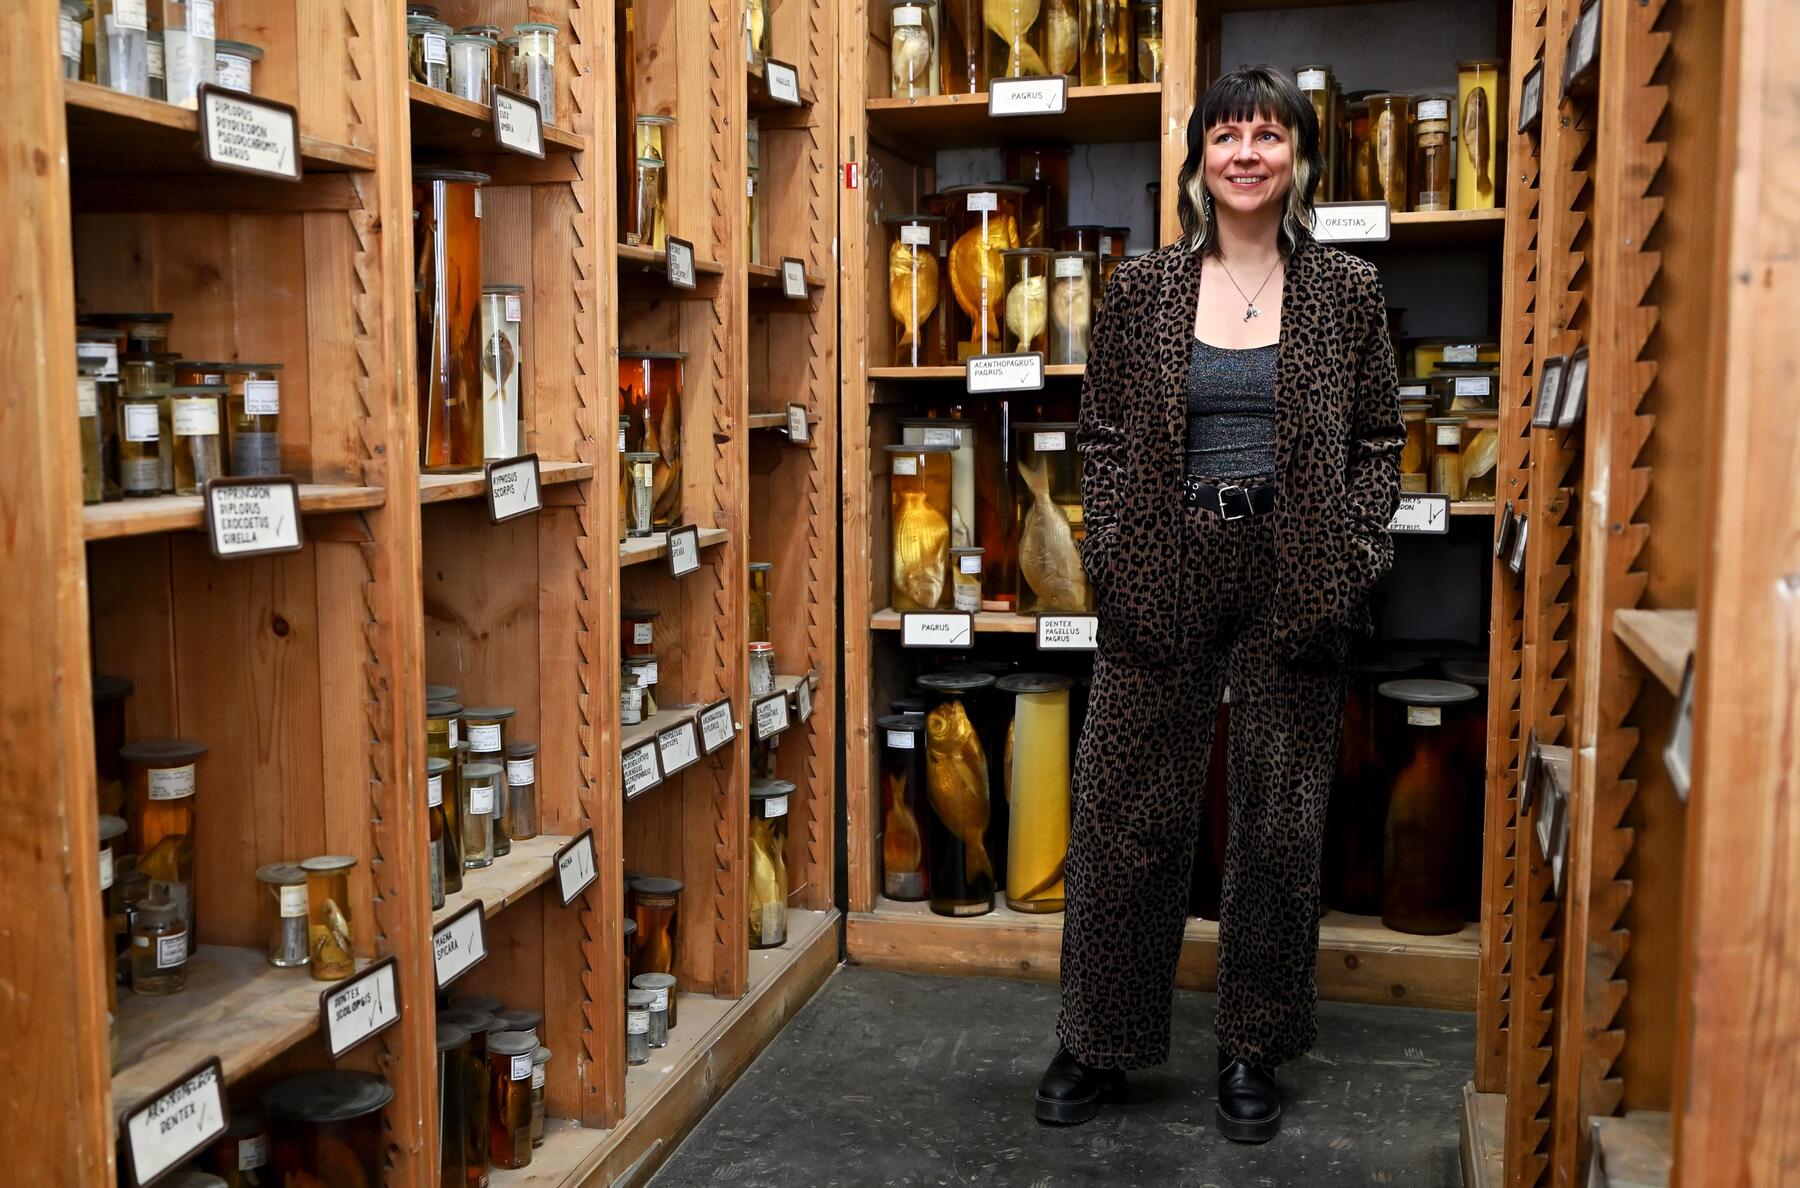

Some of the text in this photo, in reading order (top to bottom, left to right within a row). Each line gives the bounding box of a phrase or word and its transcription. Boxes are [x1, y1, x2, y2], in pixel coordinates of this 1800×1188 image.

[1011, 92, 1043, 100] PAGRUS
[1325, 218, 1366, 227] ORESTIAS
[974, 359, 1034, 369] ACANTHOPAGRUS
[974, 369, 1003, 377] PAGRUS
[493, 471, 518, 485] KYPHOSUS
[494, 484, 515, 498] SCORPIS
[220, 502, 261, 515] DIPLODUS
[222, 532, 257, 545] GIRELLA
[921, 623, 950, 632] PAGRUS
[1045, 620, 1072, 628] DENTEX
[1045, 635, 1070, 643] PAGRUS
[437, 940, 459, 961] SPICARA
[334, 986, 360, 1009] DENTEX
[160, 1103, 196, 1135] DENTEX
